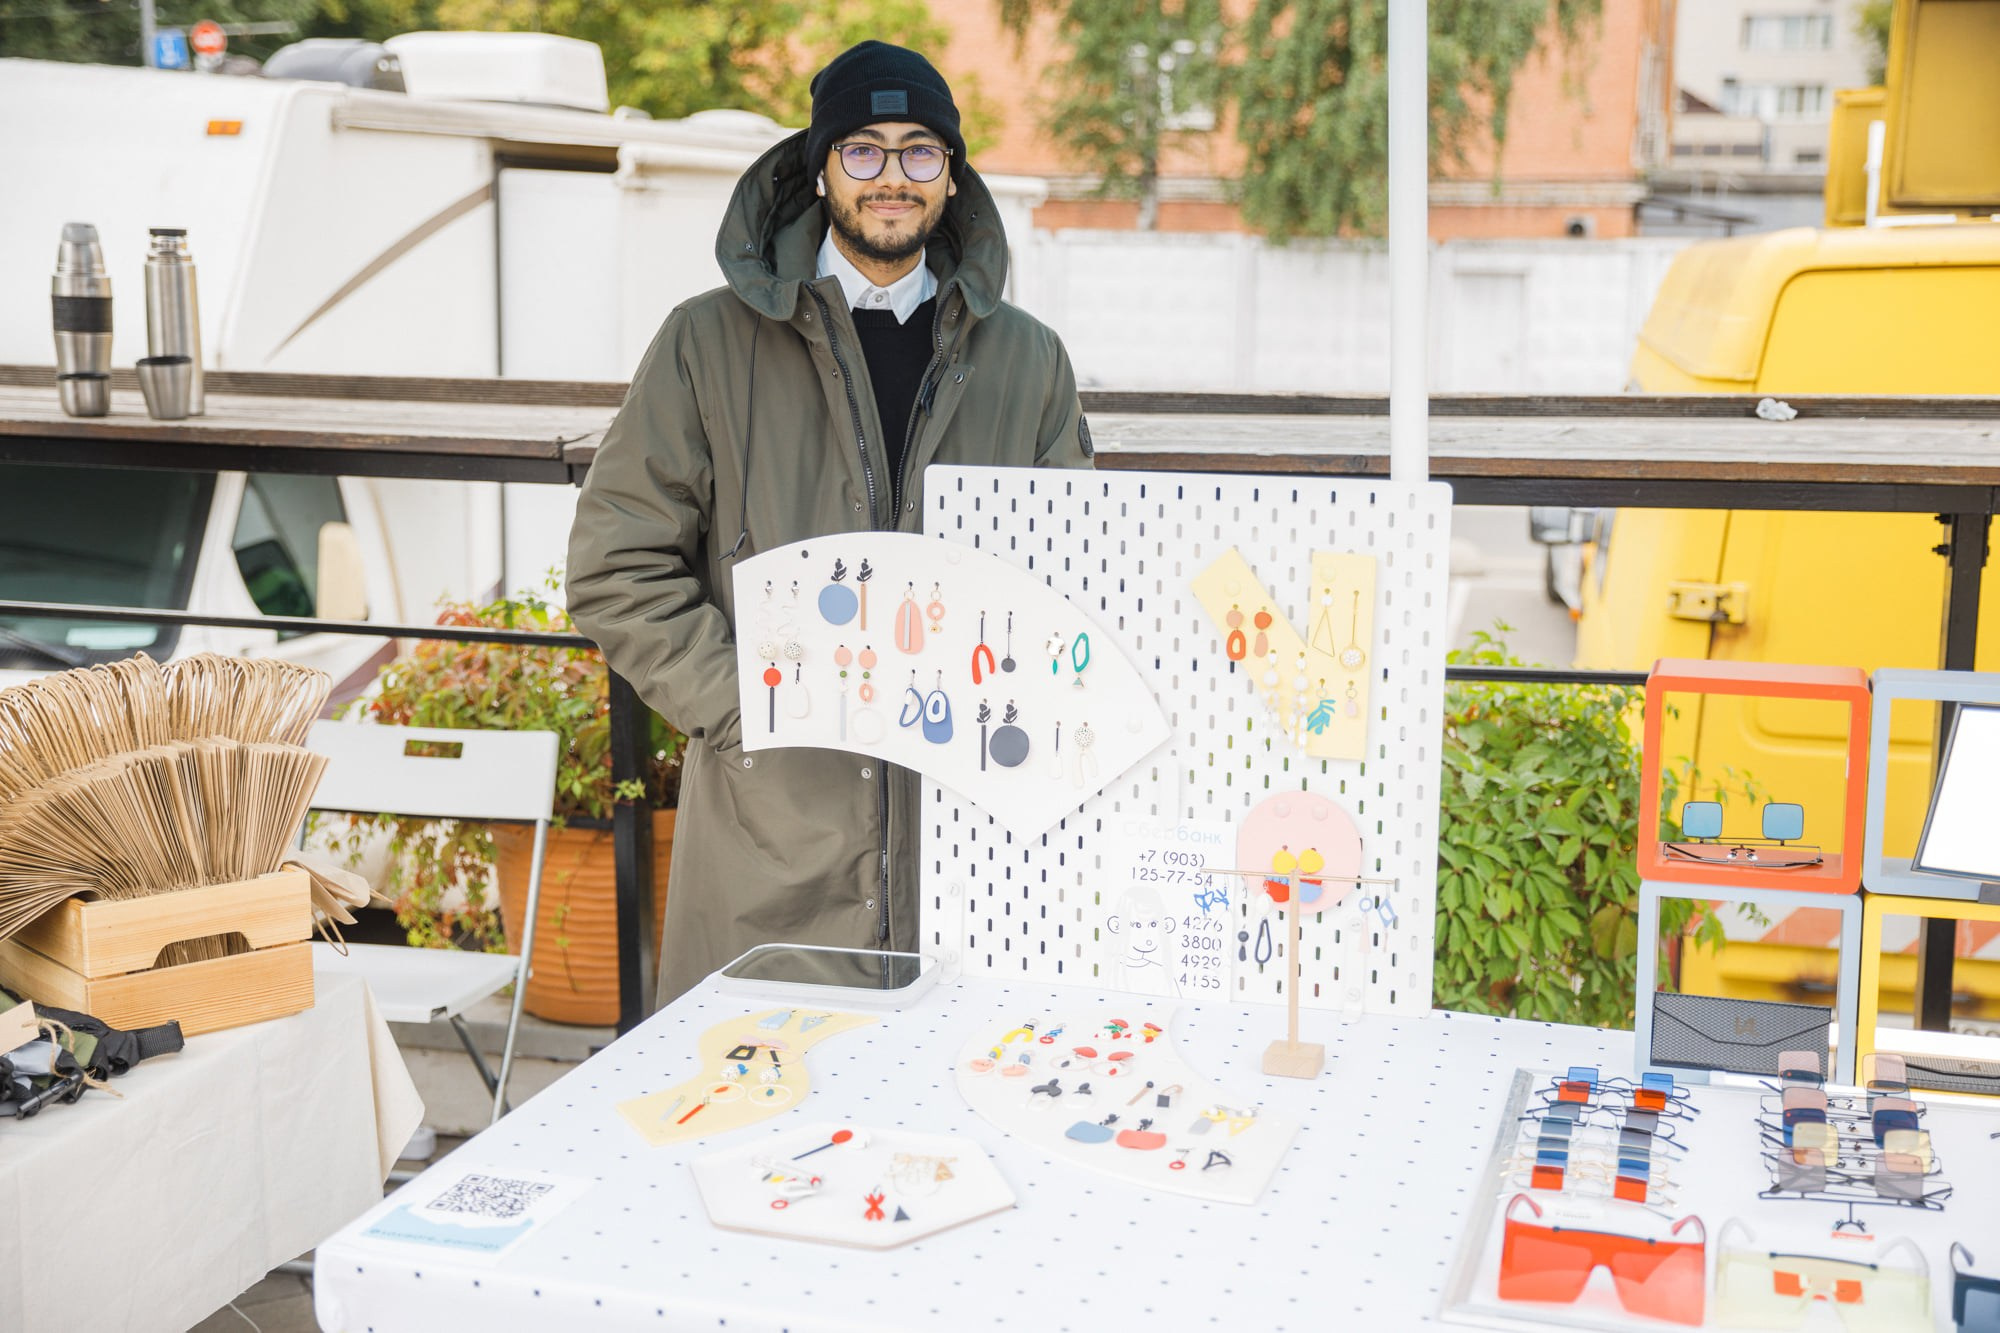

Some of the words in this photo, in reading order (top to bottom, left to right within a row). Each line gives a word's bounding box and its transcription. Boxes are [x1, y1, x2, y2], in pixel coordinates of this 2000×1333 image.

[1138, 850, 1157, 863] +7
[1163, 851, 1205, 868] (903)
[1131, 867, 1213, 887] 125-77-54
[1181, 934, 1222, 951] 3800
[1181, 954, 1221, 970] 4929
[1179, 973, 1221, 989] 4155
